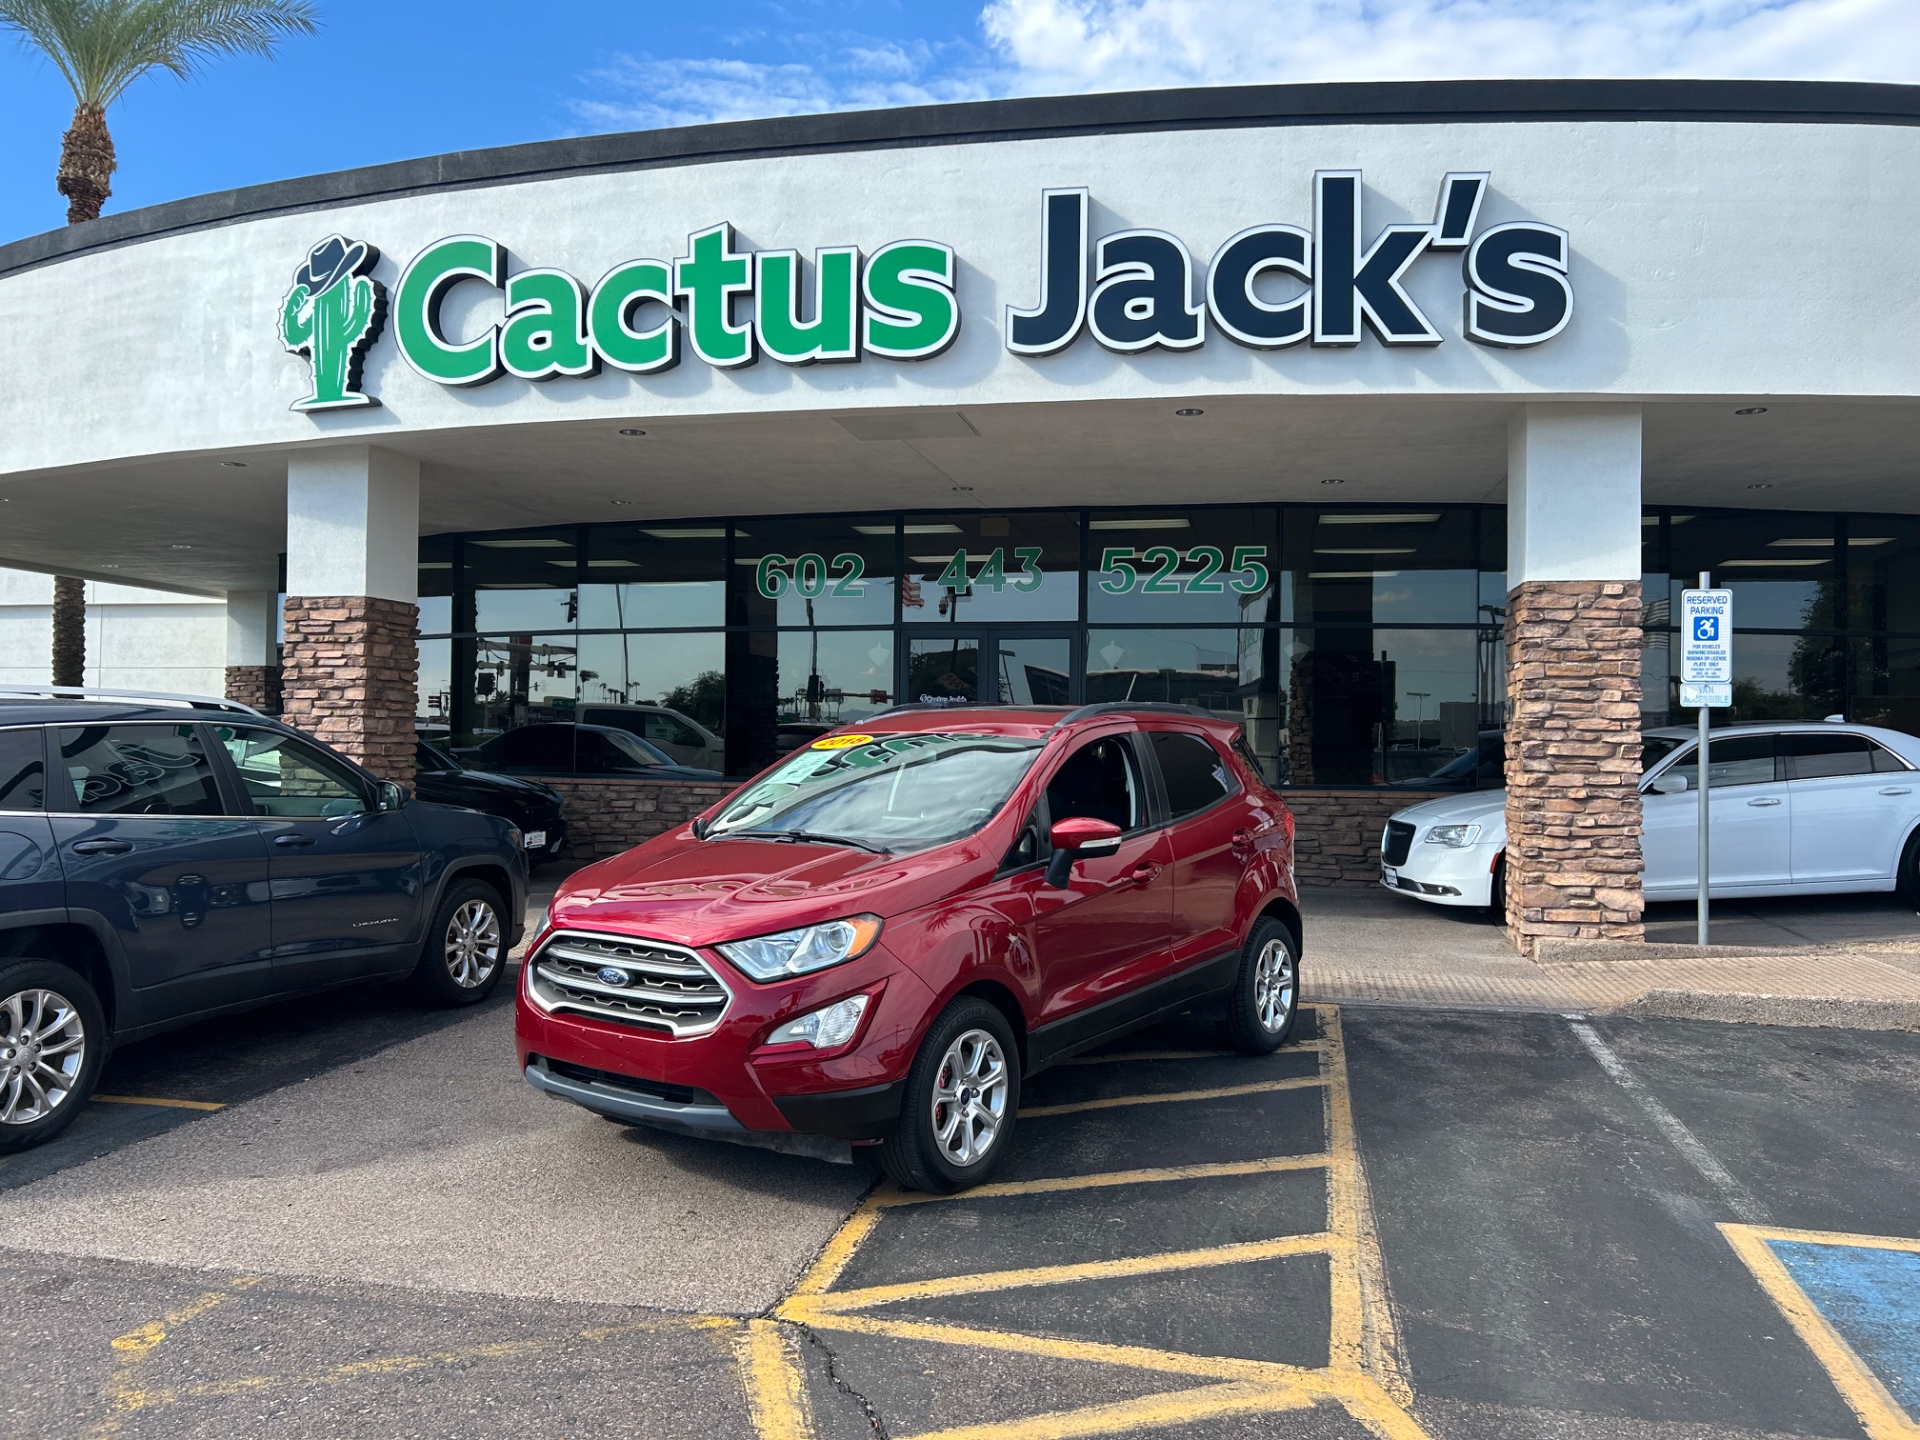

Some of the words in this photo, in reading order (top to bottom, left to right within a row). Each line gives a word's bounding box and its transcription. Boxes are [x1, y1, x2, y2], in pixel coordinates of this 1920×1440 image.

[394, 221, 960, 386] Cactus
[1005, 168, 1575, 356] Jack's
[756, 552, 865, 599] 602
[937, 547, 1044, 594] 443
[1099, 545, 1269, 594] 5225
[1686, 595, 1728, 605] RESERVED
[1690, 606, 1724, 615] PARKING
[1698, 685, 1714, 694] VAN
